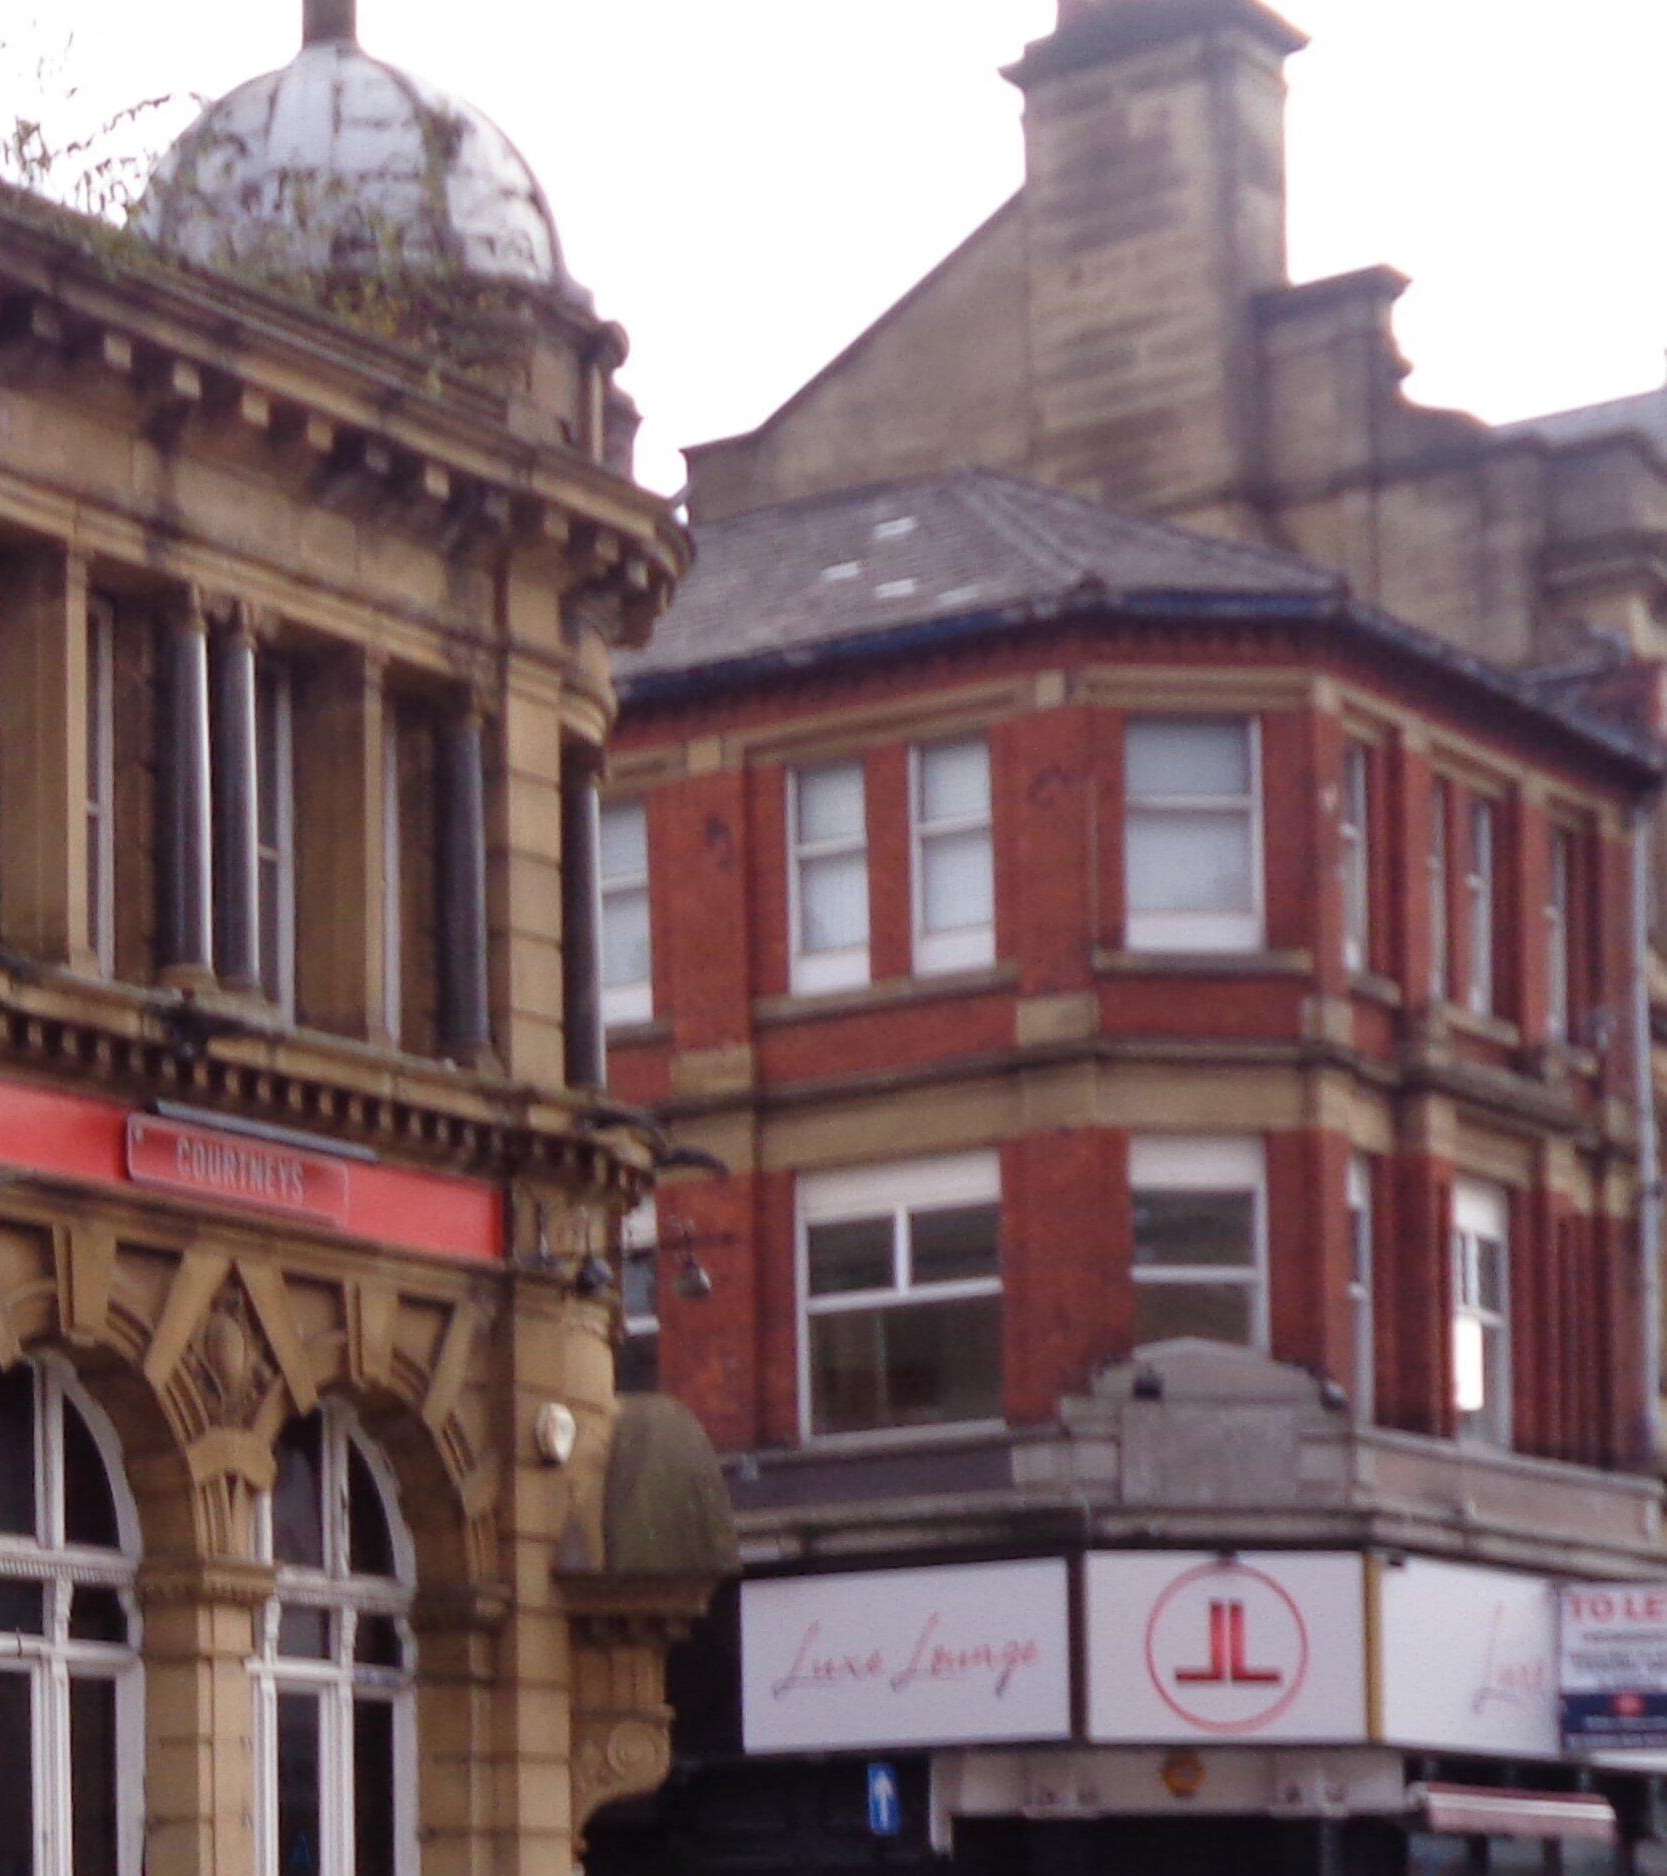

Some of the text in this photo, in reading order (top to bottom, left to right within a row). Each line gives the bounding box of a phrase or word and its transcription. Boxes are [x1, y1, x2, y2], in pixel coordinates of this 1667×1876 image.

[176, 1136, 305, 1204] COURTNEYS
[1570, 1593, 1614, 1622] TO
[889, 1611, 1041, 1700] Lounge
